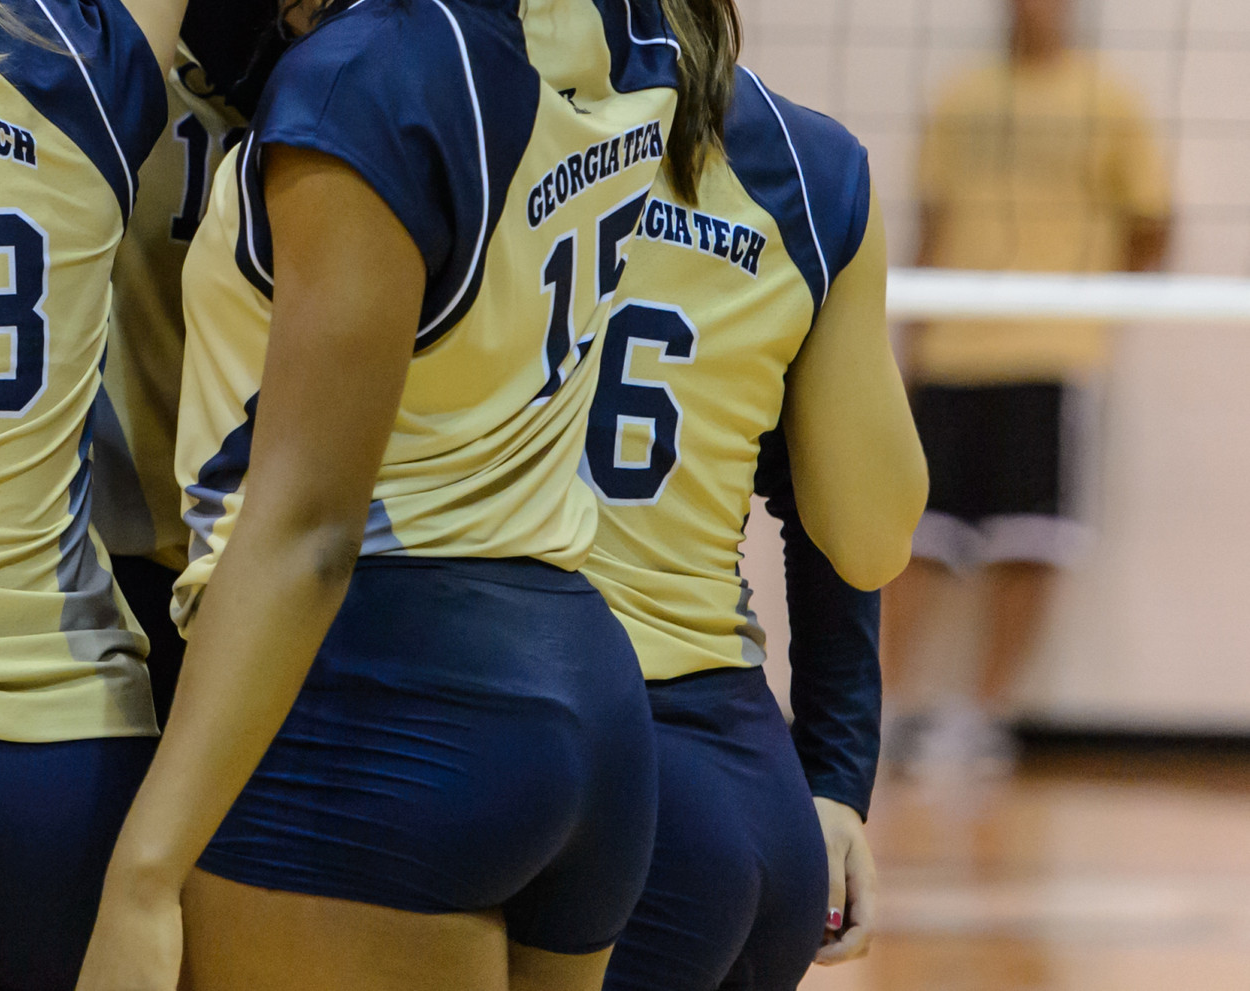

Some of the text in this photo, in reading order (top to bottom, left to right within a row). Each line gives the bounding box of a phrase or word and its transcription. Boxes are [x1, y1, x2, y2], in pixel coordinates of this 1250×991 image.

[527, 134, 623, 230] GEORGIA
[693, 210, 768, 279] TECH
[579, 297, 699, 506] 6
